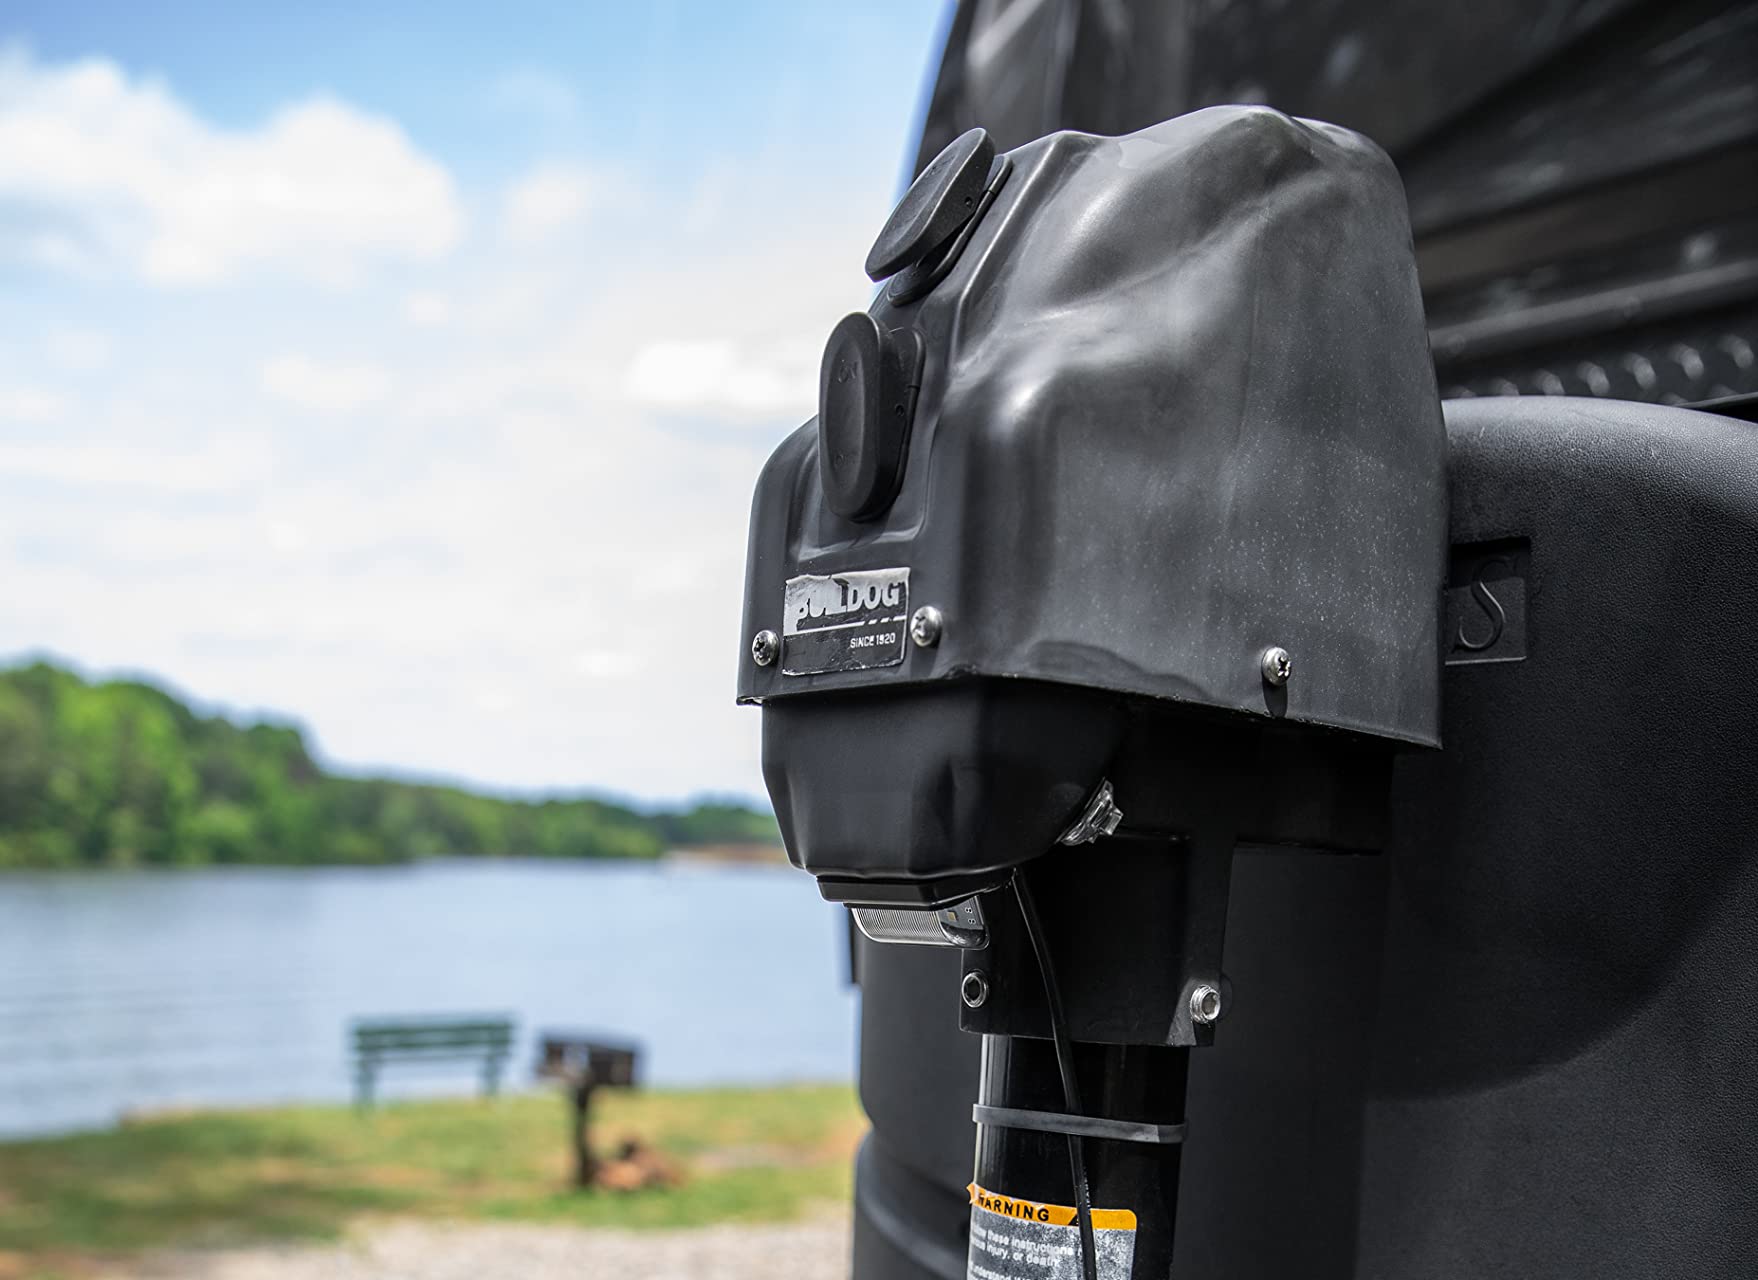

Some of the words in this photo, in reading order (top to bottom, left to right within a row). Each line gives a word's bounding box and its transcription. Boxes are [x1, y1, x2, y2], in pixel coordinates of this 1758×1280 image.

[797, 582, 900, 620] BULDOG
[850, 636, 874, 649] SINCE
[1012, 1236, 1074, 1256] instructions
[1013, 1252, 1024, 1261] or
